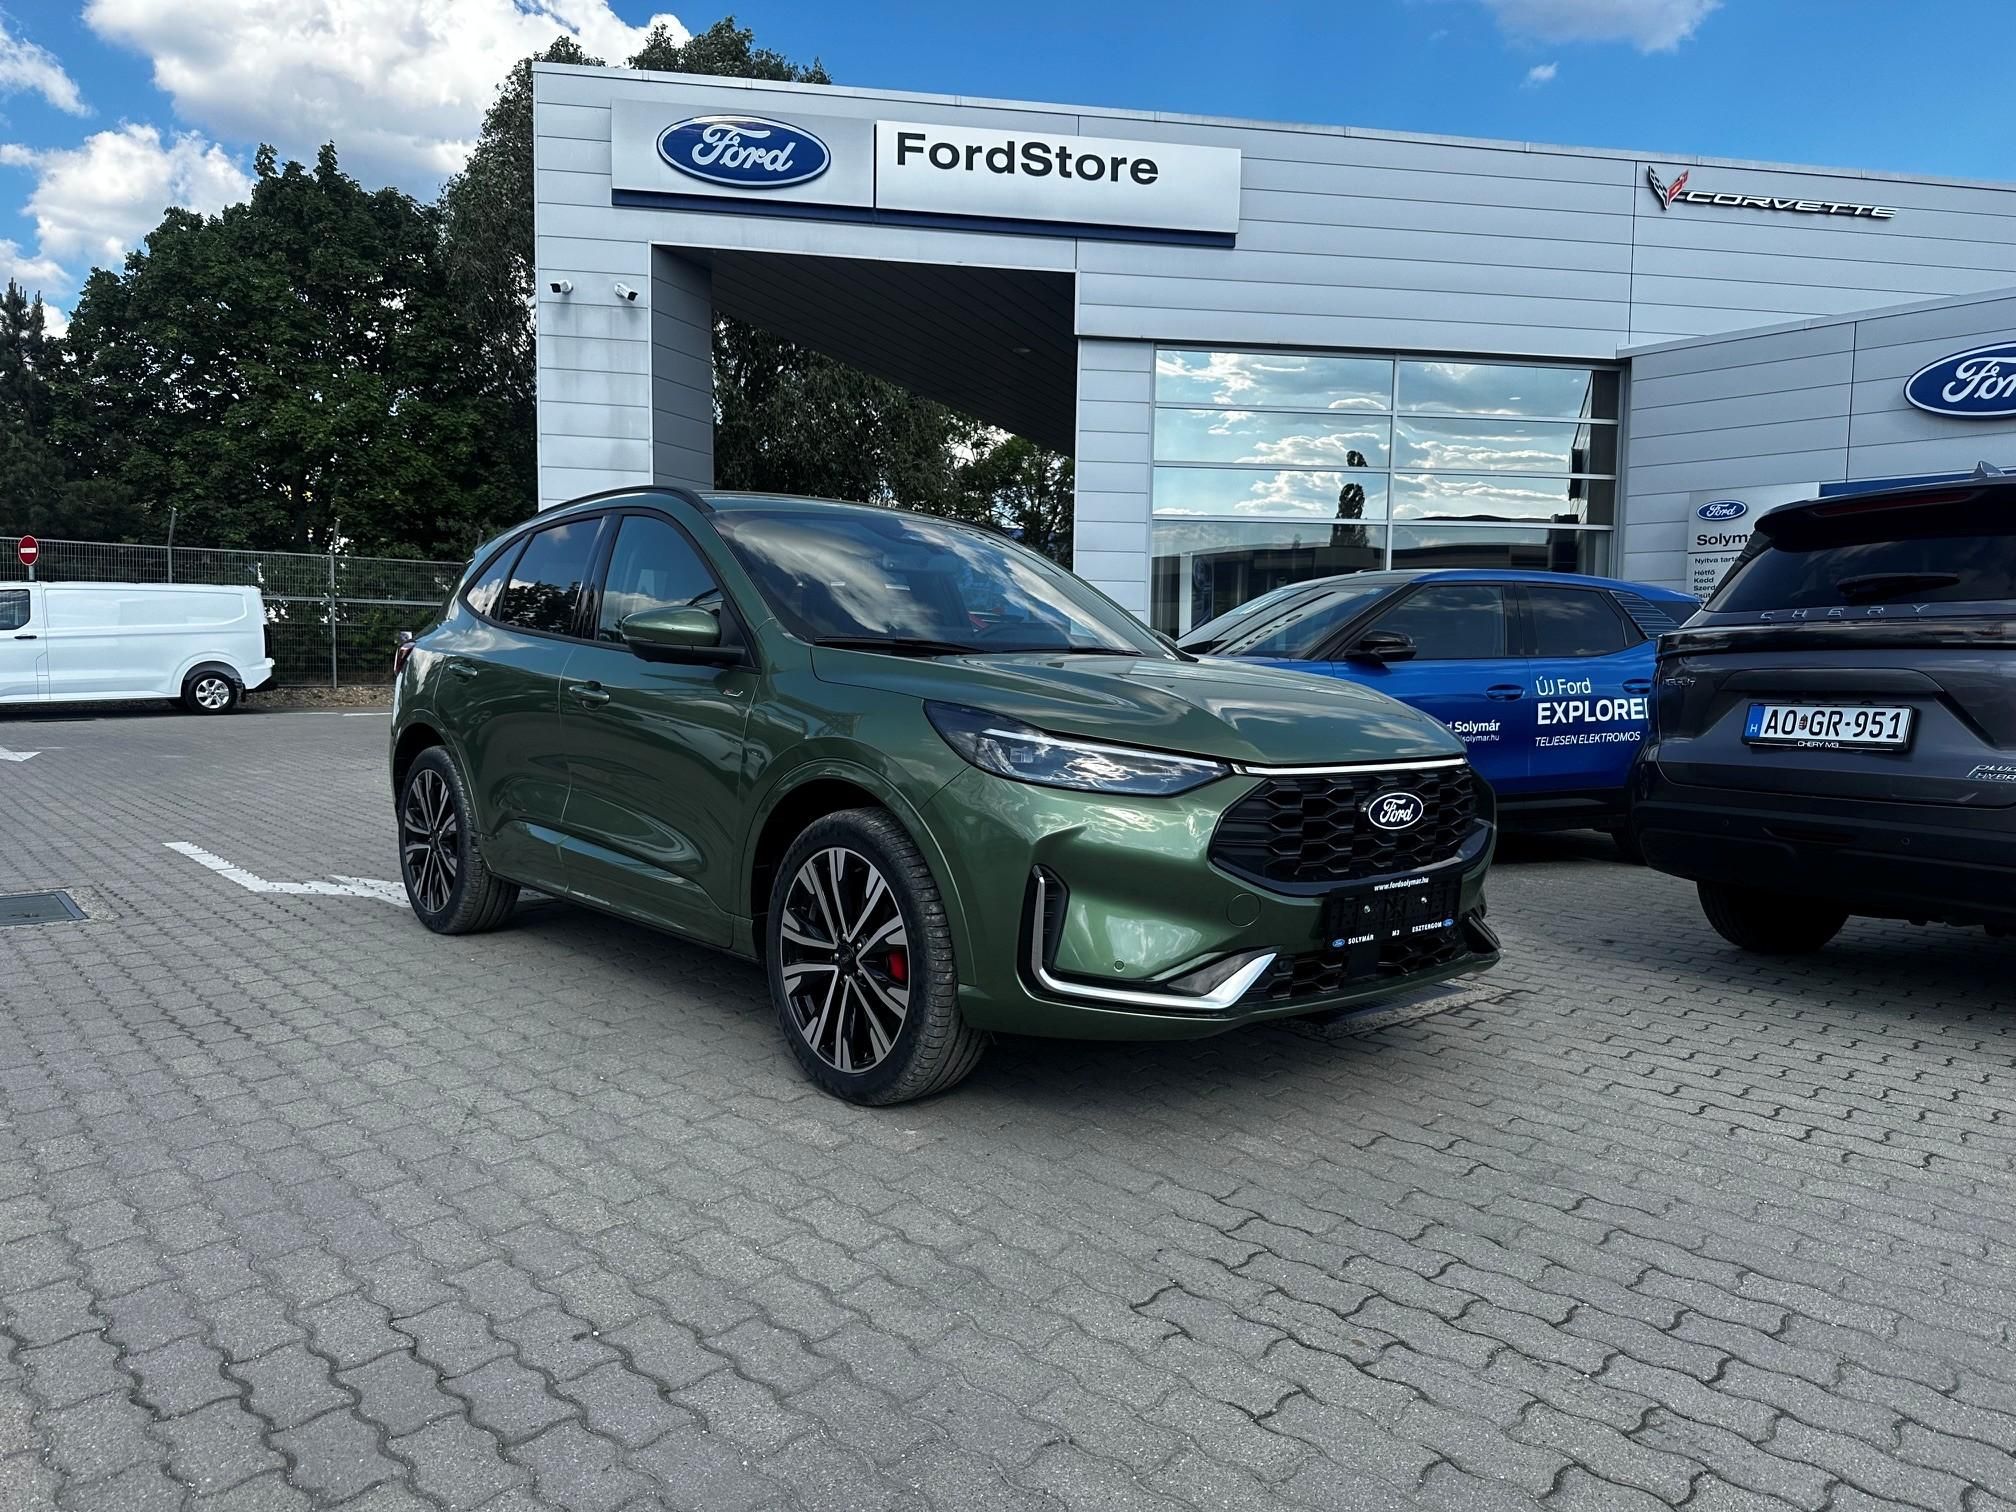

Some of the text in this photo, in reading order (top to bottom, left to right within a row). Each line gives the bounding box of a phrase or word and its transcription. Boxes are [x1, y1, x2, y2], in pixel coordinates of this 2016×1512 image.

[690, 124, 796, 173] Ford
[896, 132, 1160, 186] FordStore
[1686, 191, 1897, 218] CORVETTE
[1941, 356, 2016, 404] For
[1706, 503, 1736, 516] Ford
[1697, 533, 1749, 546] Solym
[1695, 557, 1719, 565] Nyitva
[1760, 604, 1928, 620] CHERY
[1558, 678, 1591, 694] Ford
[1455, 719, 1501, 735] Solymár
[1808, 710, 1901, 739] GR-951
[1463, 734, 1499, 744] solymar.hu
[1535, 731, 1641, 747] TELJESEN ELEKTROMOS
[1974, 772, 2016, 780] HYBR
[1380, 798, 1414, 823] Ford
